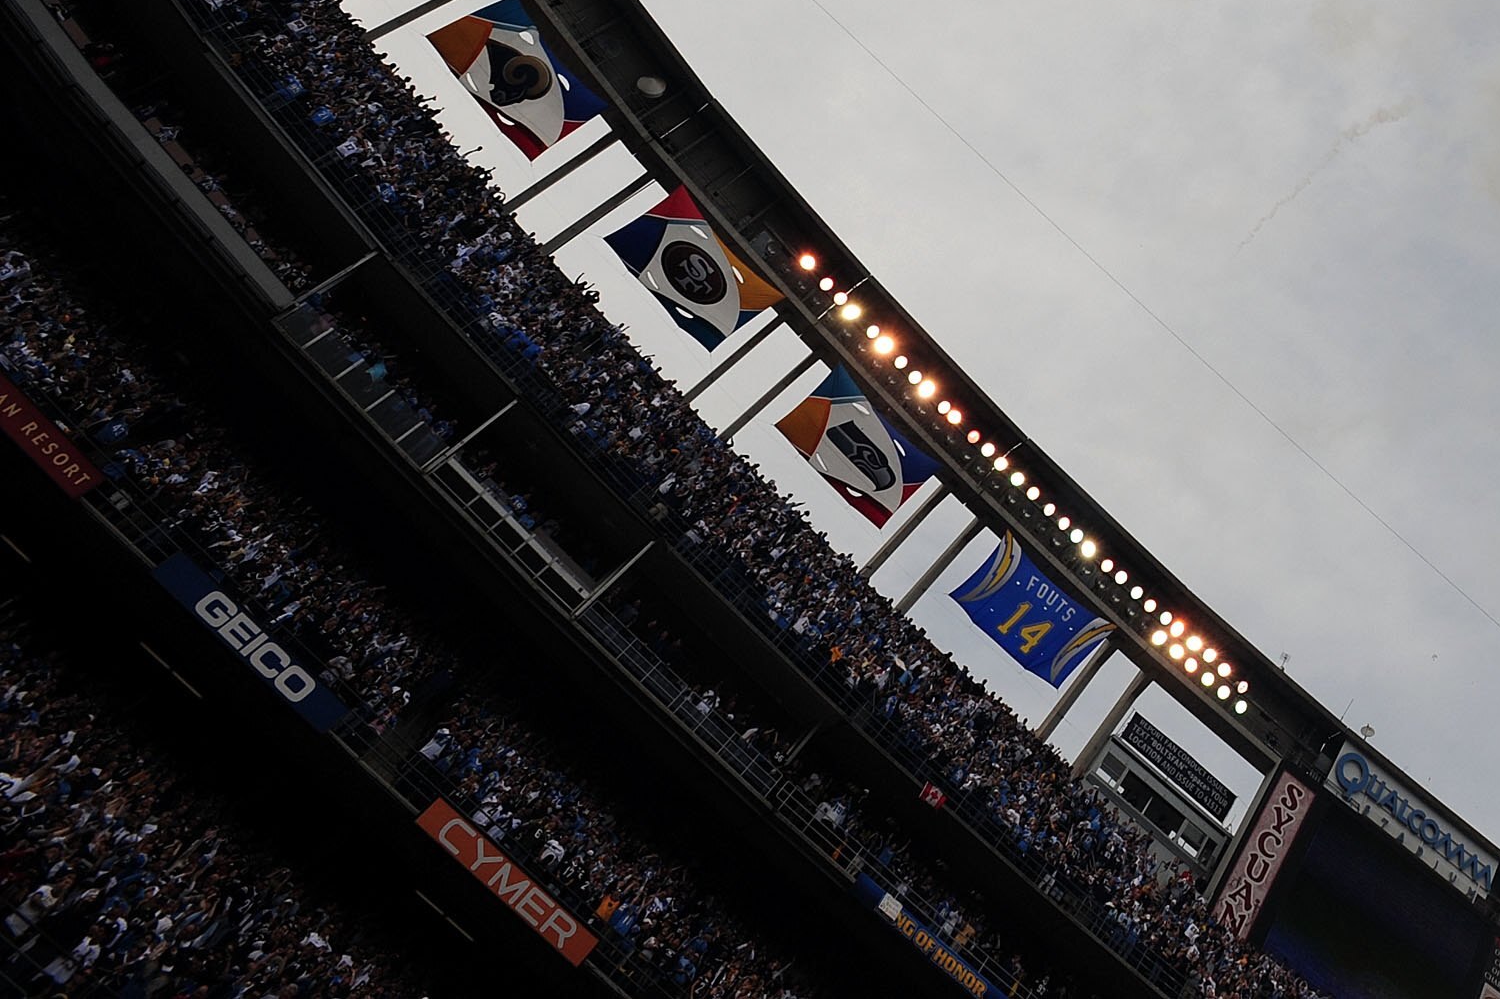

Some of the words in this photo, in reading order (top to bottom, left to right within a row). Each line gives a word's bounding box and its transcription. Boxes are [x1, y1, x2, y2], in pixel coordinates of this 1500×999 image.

[20, 420, 92, 486] RESORT
[997, 601, 1055, 654] 14
[1026, 575, 1076, 622] FOUTS
[194, 590, 317, 703] GEICO
[1128, 732, 1163, 764] LOCATION
[1160, 760, 1177, 777] AND
[1174, 773, 1196, 792] ISSUE
[1194, 786, 1205, 800] TO
[1132, 722, 1151, 741] TEXT
[1210, 788, 1229, 809] YOUR
[1139, 719, 1164, 741] REPORT
[1163, 738, 1179, 754] FAN
[1177, 750, 1207, 777] CONDUCT
[1335, 752, 1492, 891] QUALCOMM
[438, 817, 577, 950] CYMER
[1218, 784, 1304, 938] SYCUAN
[914, 930, 936, 953] OF
[932, 946, 987, 999] HONOR
